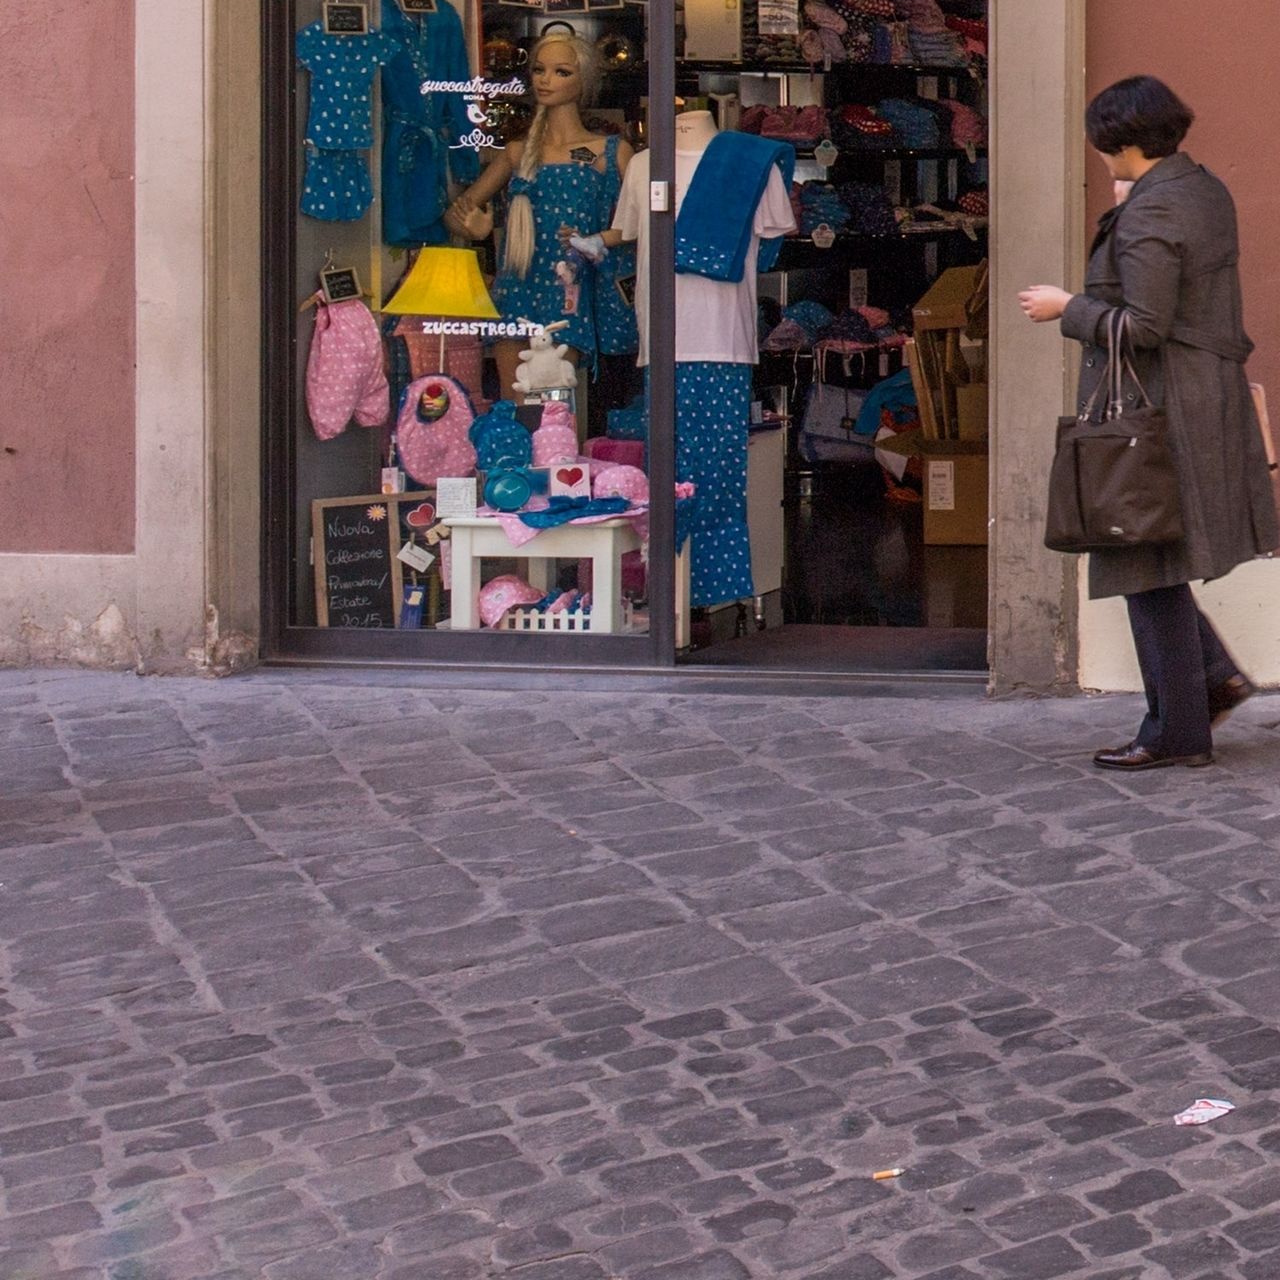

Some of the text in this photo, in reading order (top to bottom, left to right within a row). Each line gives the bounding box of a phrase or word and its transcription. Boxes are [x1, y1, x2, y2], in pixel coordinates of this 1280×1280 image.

[420, 75, 526, 99] zuccastregata
[329, 517, 375, 537] Nuova
[330, 596, 372, 610] Estate
[342, 613, 382, 627] 2015
